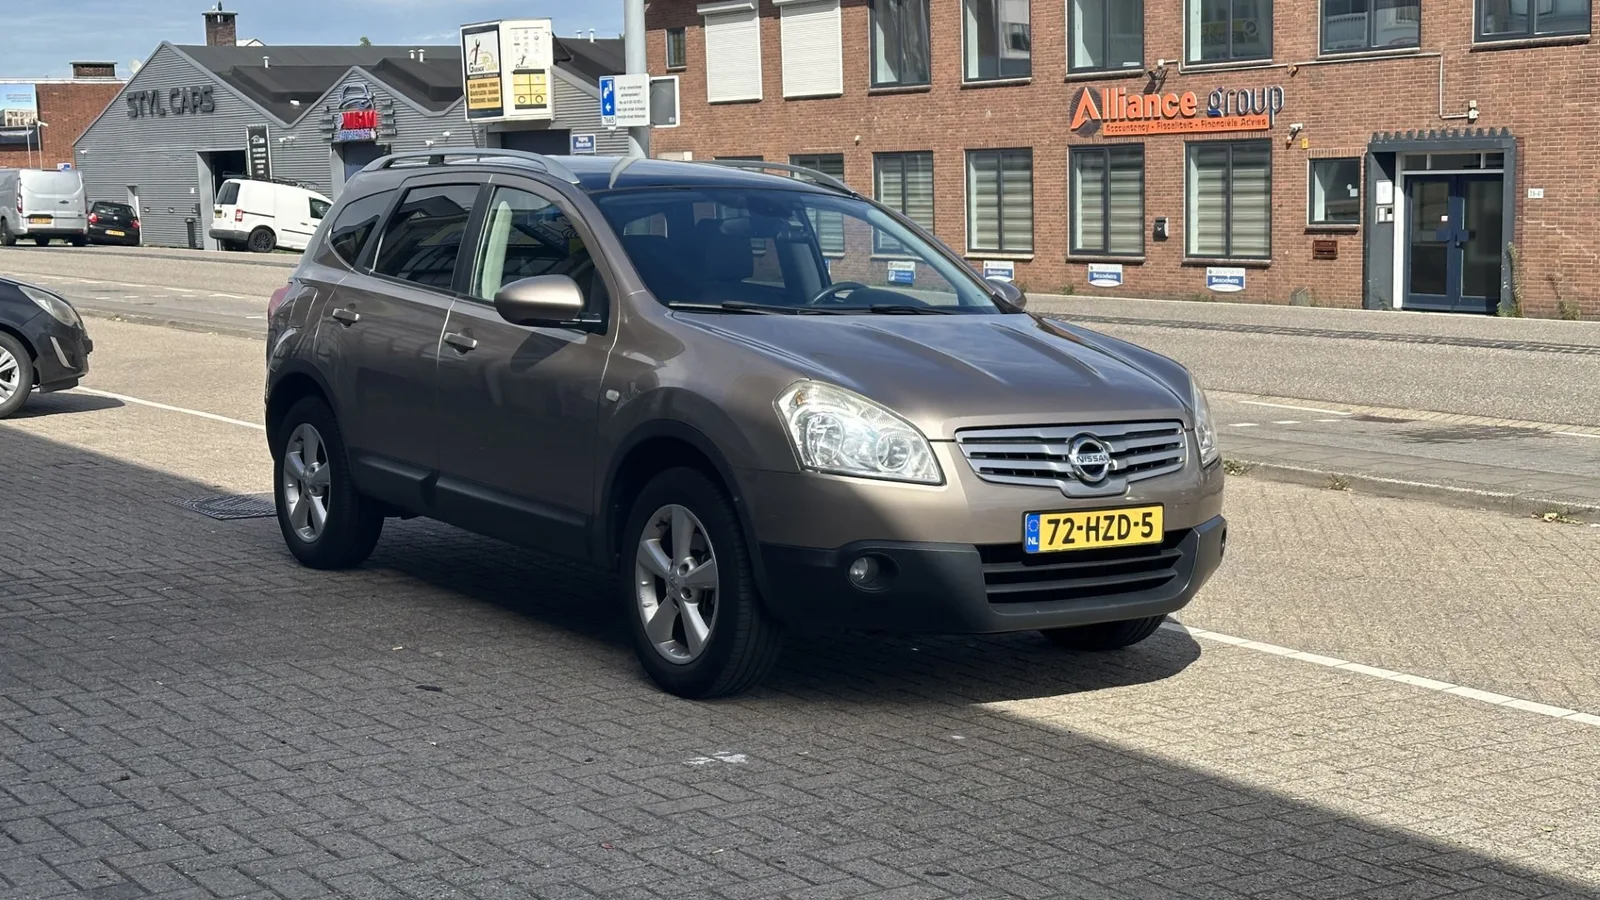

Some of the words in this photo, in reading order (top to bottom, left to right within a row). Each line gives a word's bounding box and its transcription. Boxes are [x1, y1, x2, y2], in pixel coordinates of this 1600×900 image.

[126, 90, 166, 118] STYL
[169, 85, 215, 114] CARS
[1070, 87, 1198, 131] Alliance
[1207, 85, 1285, 130] group
[1106, 124, 1150, 133] Accountancy
[1156, 121, 1193, 130] Fiscaliteit
[1240, 118, 1267, 127] Advies
[1076, 454, 1109, 463] NISSAN
[1047, 512, 1153, 545] 72-HZD-5
[1028, 537, 1038, 545] NL
